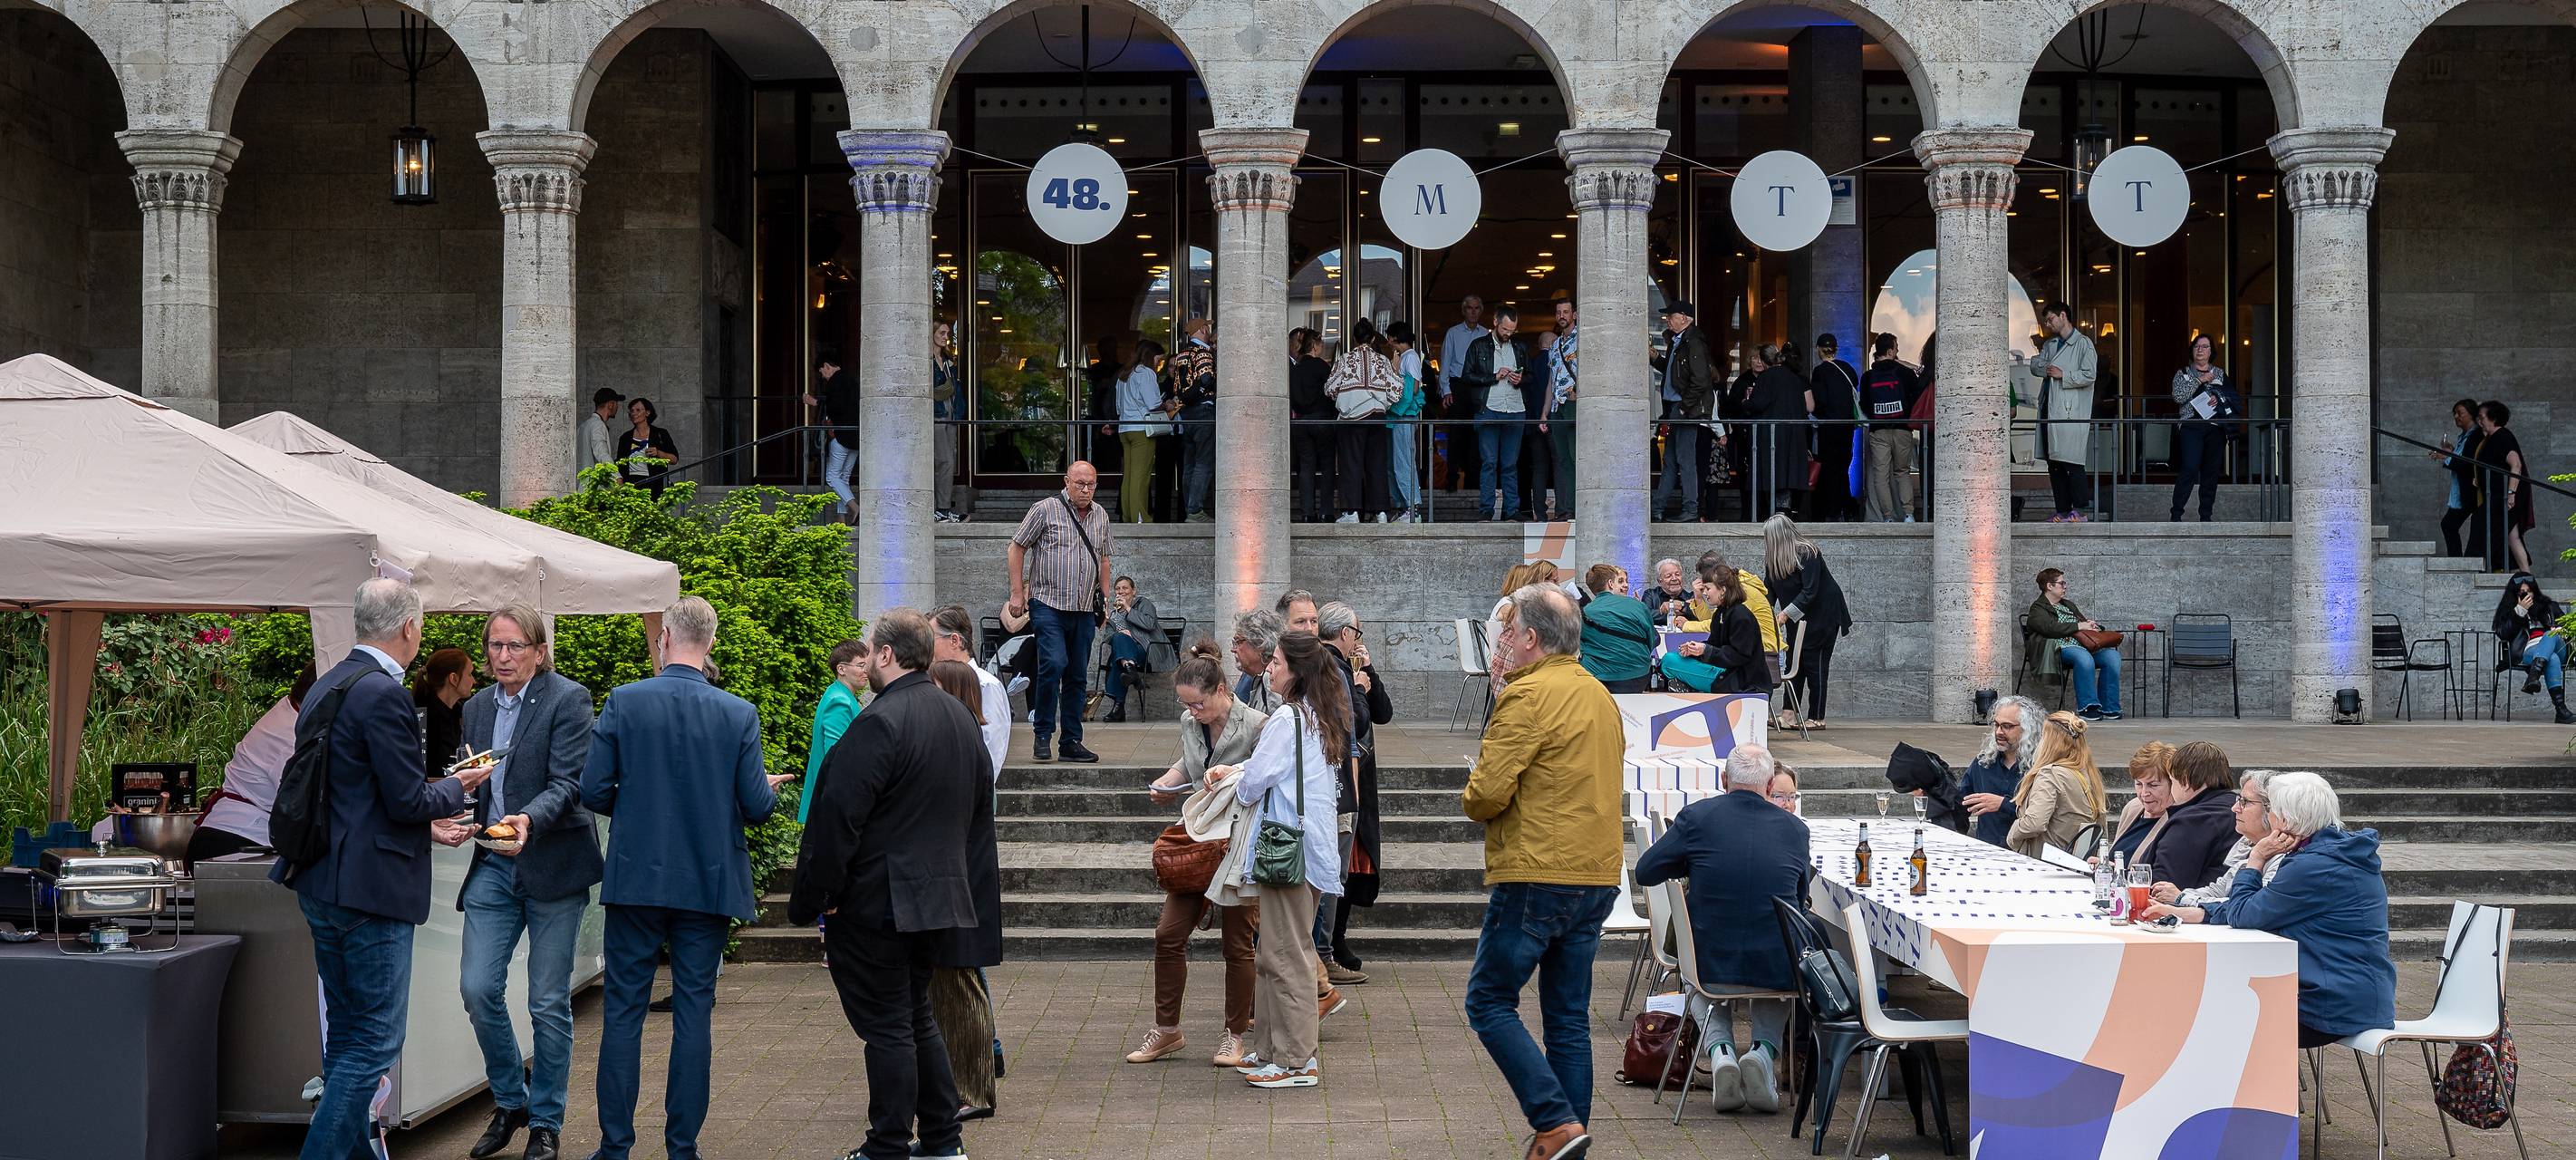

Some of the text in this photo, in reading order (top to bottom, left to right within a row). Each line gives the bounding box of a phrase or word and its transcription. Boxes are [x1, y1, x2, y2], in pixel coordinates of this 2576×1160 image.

[1042, 178, 1110, 211] 48.
[1414, 183, 1447, 216] M
[1768, 185, 1796, 217] T
[2125, 180, 2153, 213] T
[1875, 401, 1901, 413] PUMA
